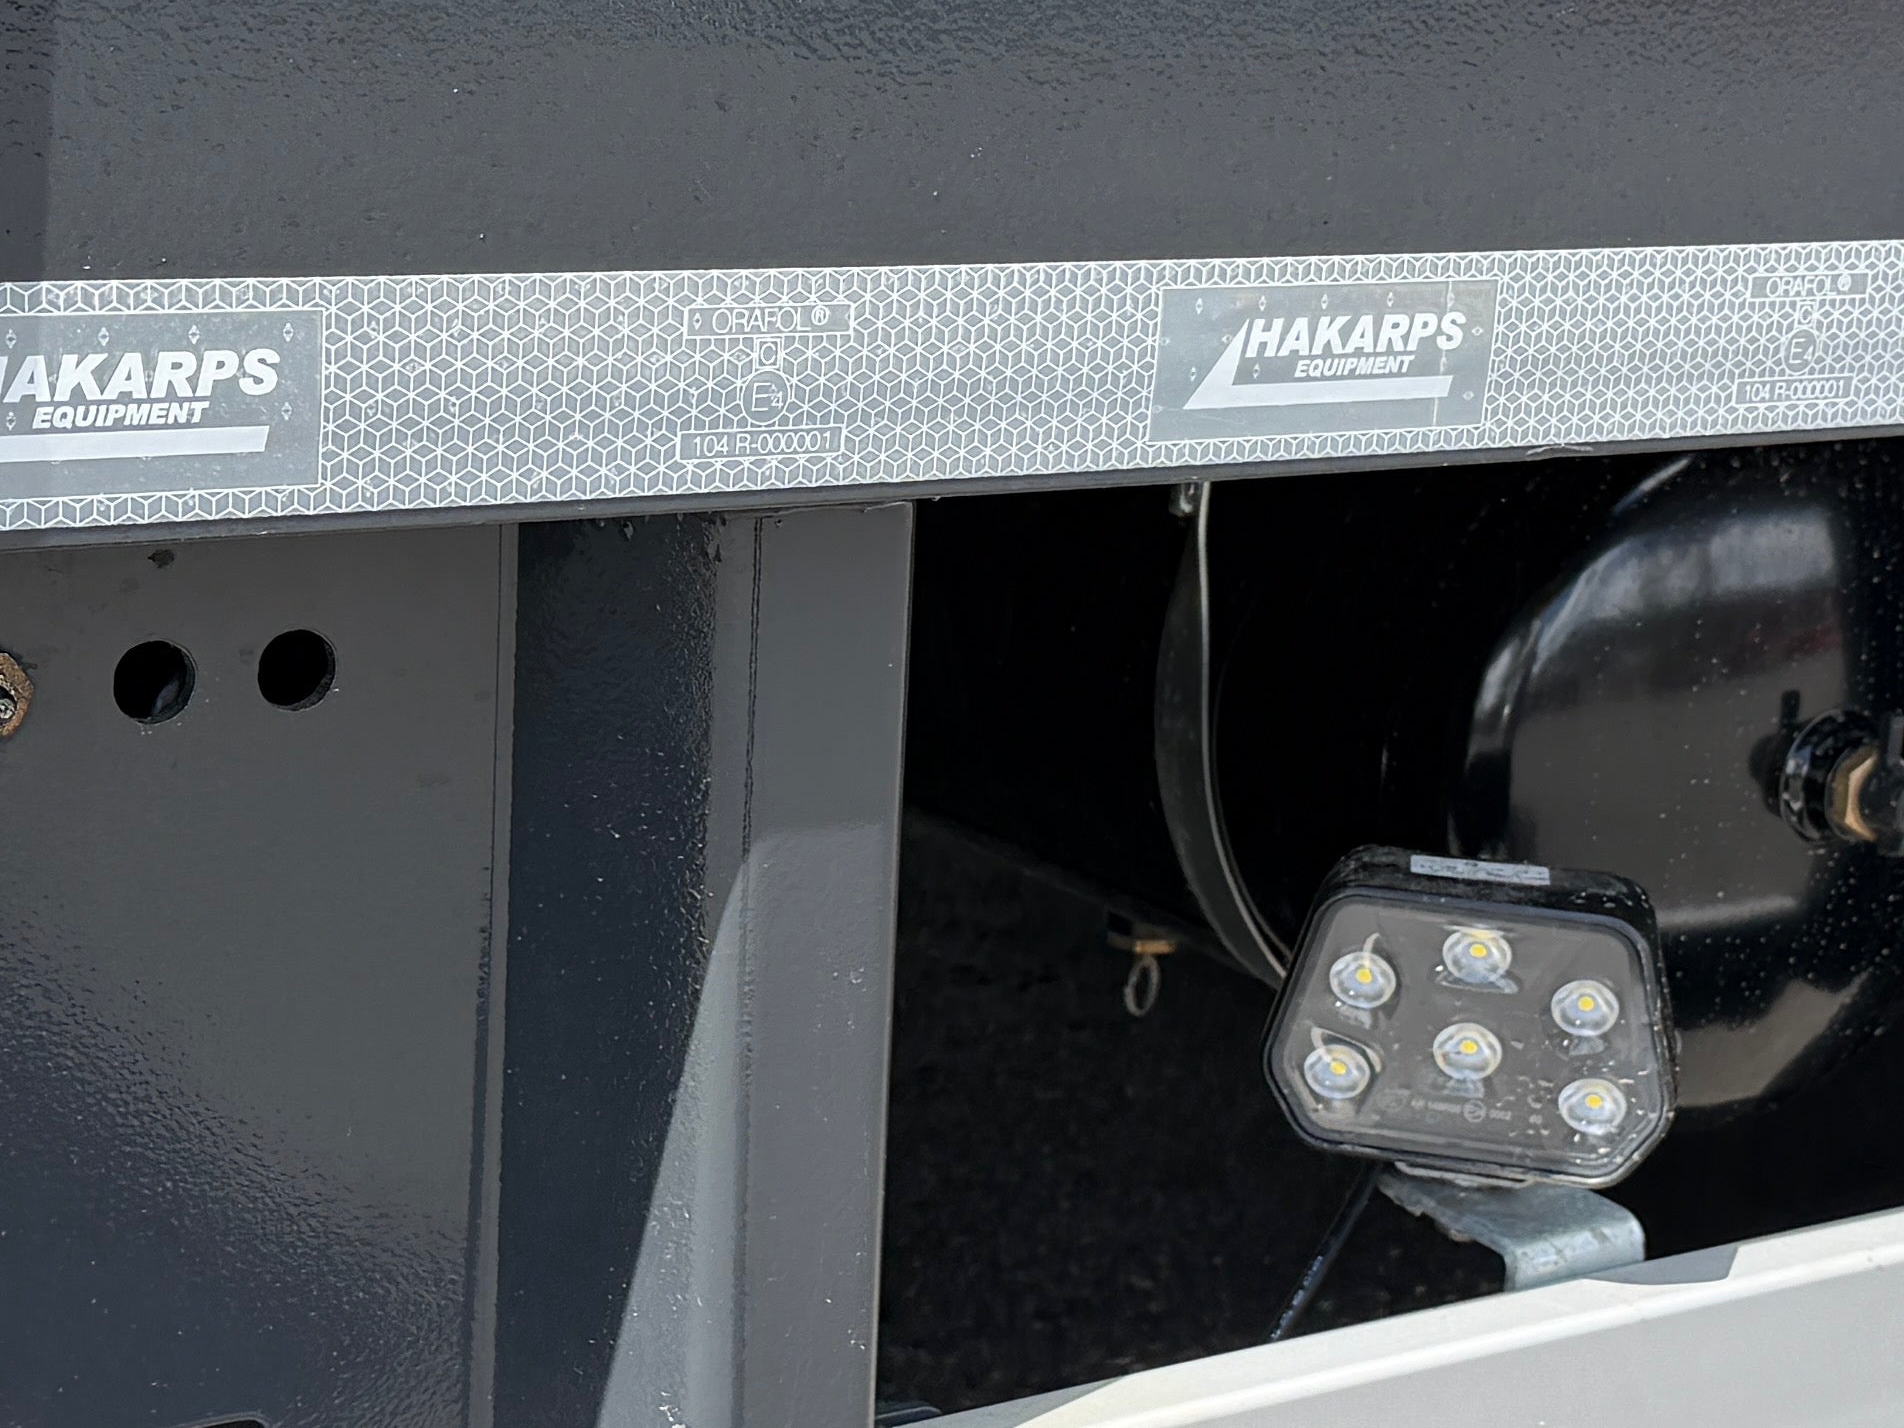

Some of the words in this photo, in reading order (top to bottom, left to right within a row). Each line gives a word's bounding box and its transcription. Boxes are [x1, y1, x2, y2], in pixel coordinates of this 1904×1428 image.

[1244, 311, 1466, 358] HAKARPS
[1294, 354, 1416, 379] EQUIPMENT
[32, 400, 210, 430] EQUIPMENT
[693, 434, 729, 457] 104
